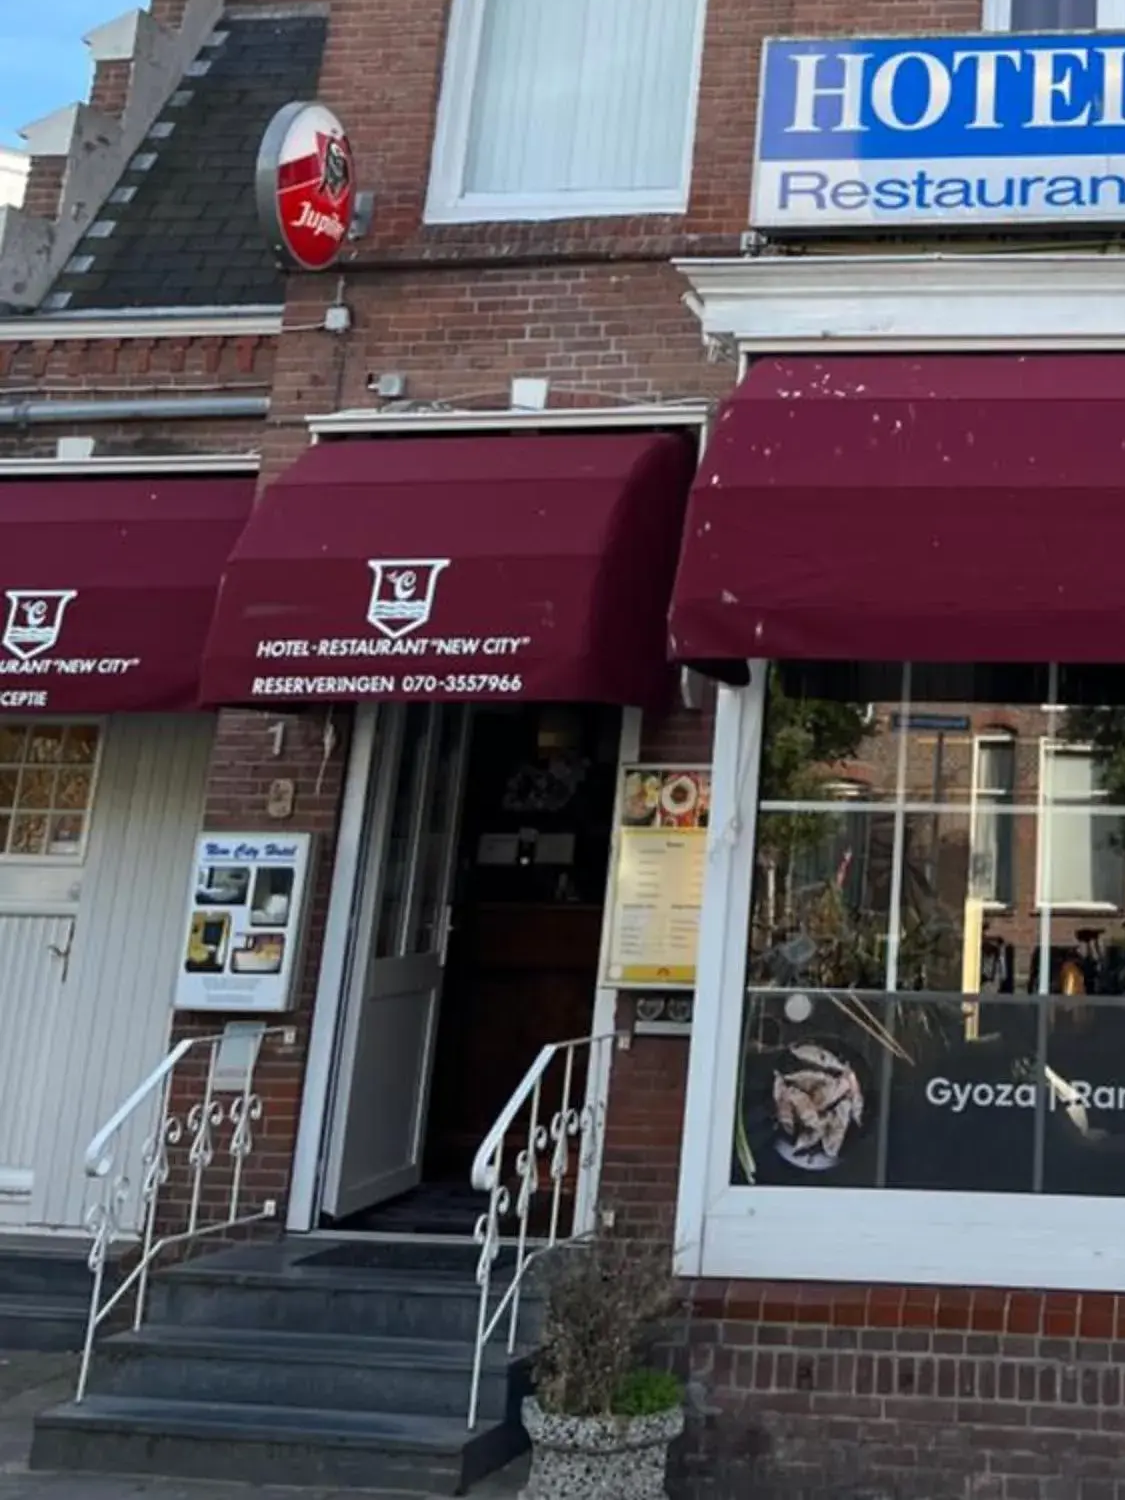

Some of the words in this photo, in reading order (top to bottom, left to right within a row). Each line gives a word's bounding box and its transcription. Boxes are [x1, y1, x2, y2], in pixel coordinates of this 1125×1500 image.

[252, 675, 395, 694] RESERVERINGEN
[402, 674, 523, 694] 070-3557966
[925, 1076, 1037, 1112] Gyoza
